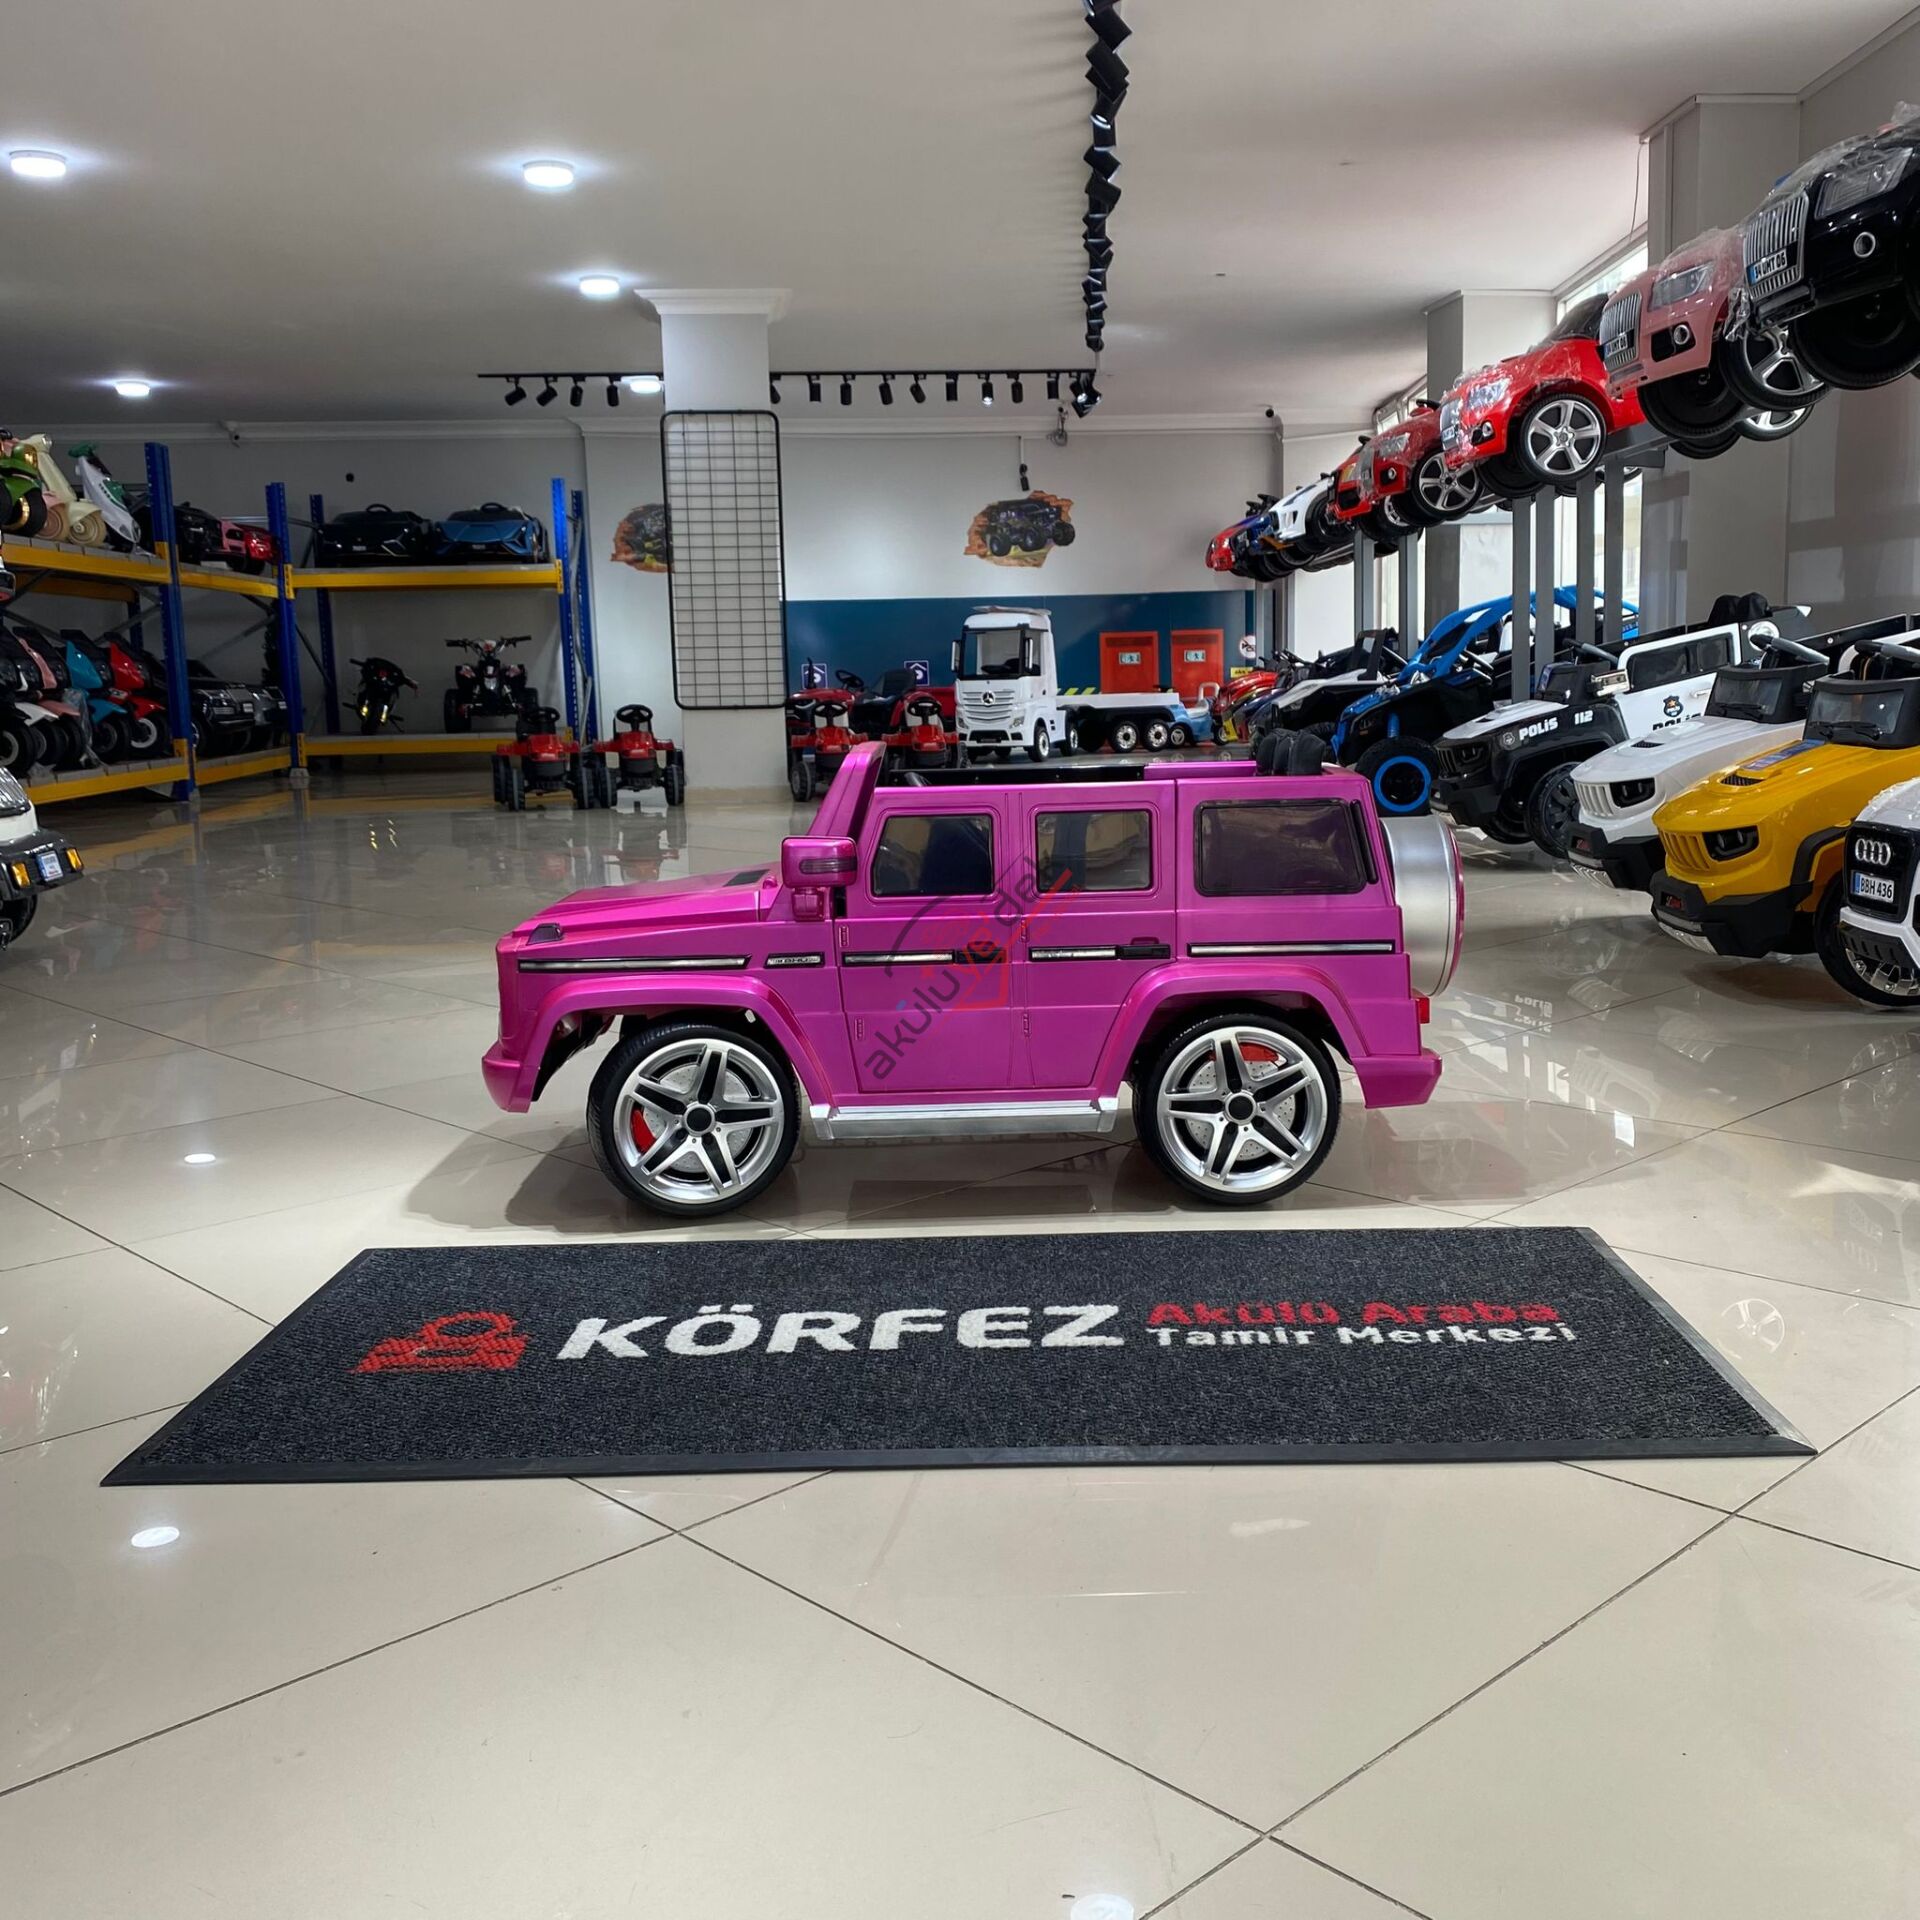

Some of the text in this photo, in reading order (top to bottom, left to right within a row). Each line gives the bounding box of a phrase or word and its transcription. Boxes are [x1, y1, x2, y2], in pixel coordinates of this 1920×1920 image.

[1574, 710, 1593, 725] 112
[1876, 882, 1893, 899] 436
[1362, 1301, 1560, 1325] Araba
[556, 1303, 1125, 1360] KÖRFEZ
[1146, 1322, 1576, 1346] Tamir Merkezi
